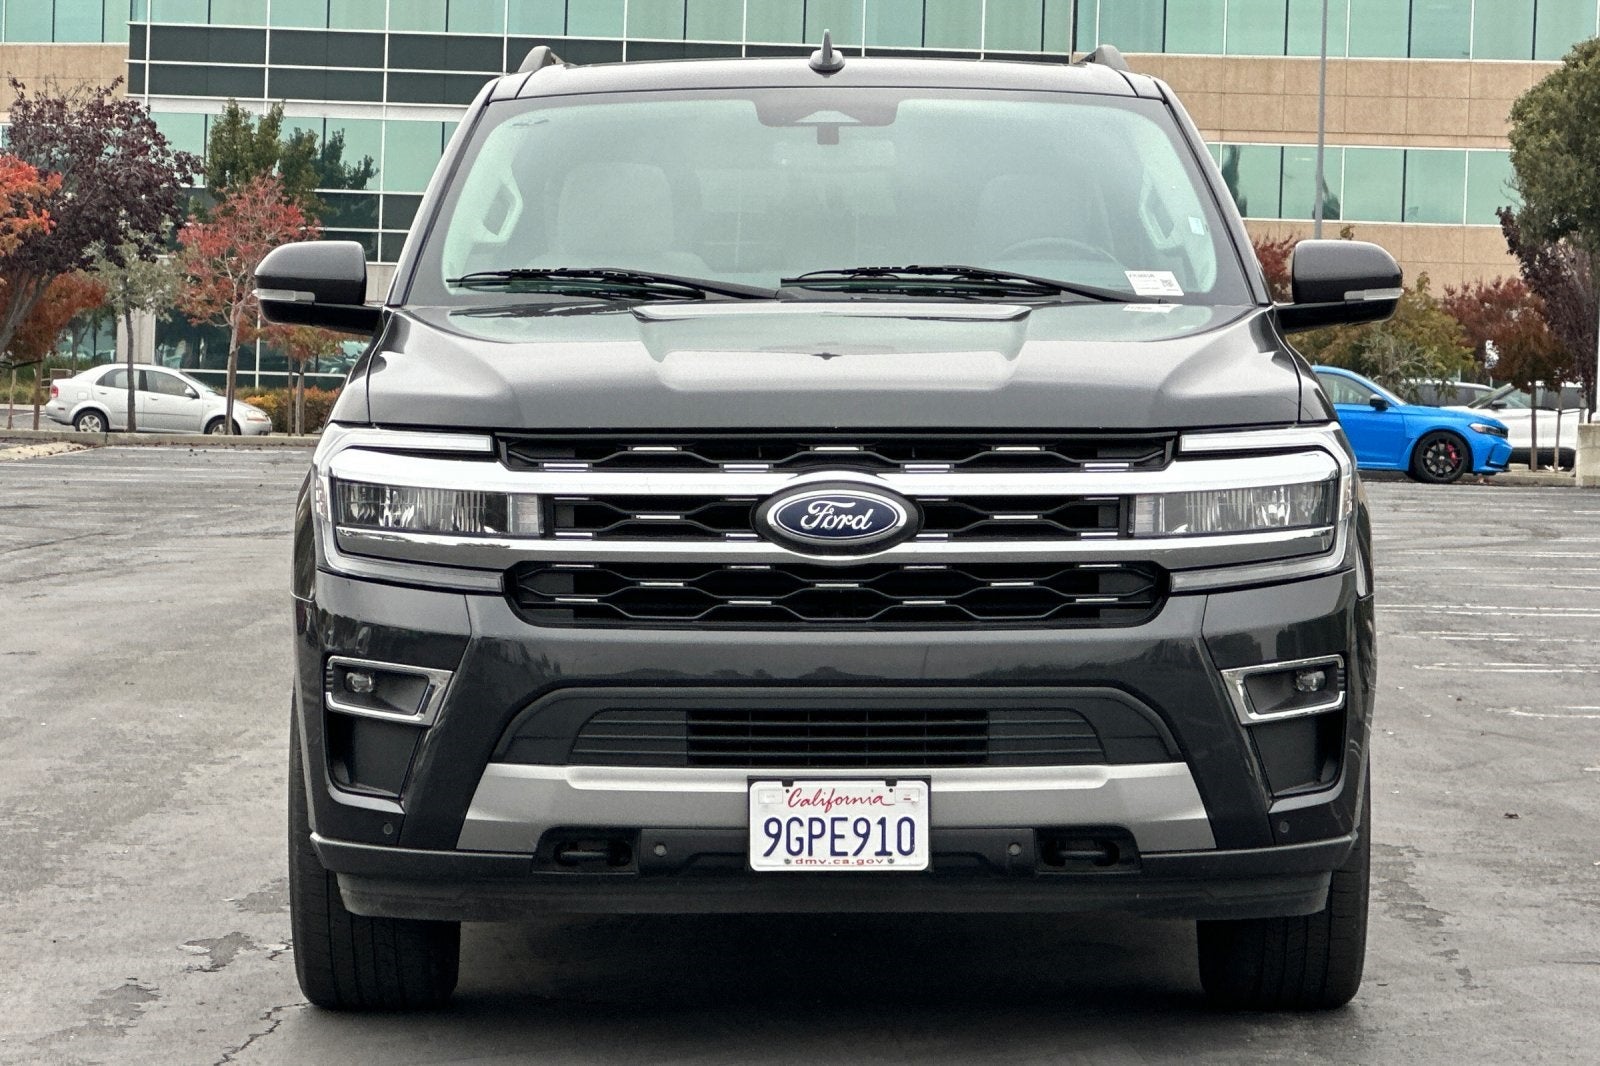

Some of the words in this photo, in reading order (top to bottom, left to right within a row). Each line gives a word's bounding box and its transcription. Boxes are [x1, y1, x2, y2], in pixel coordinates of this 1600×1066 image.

[800, 500, 874, 530] Ford
[787, 788, 895, 813] California
[763, 816, 915, 857] 9GPE910
